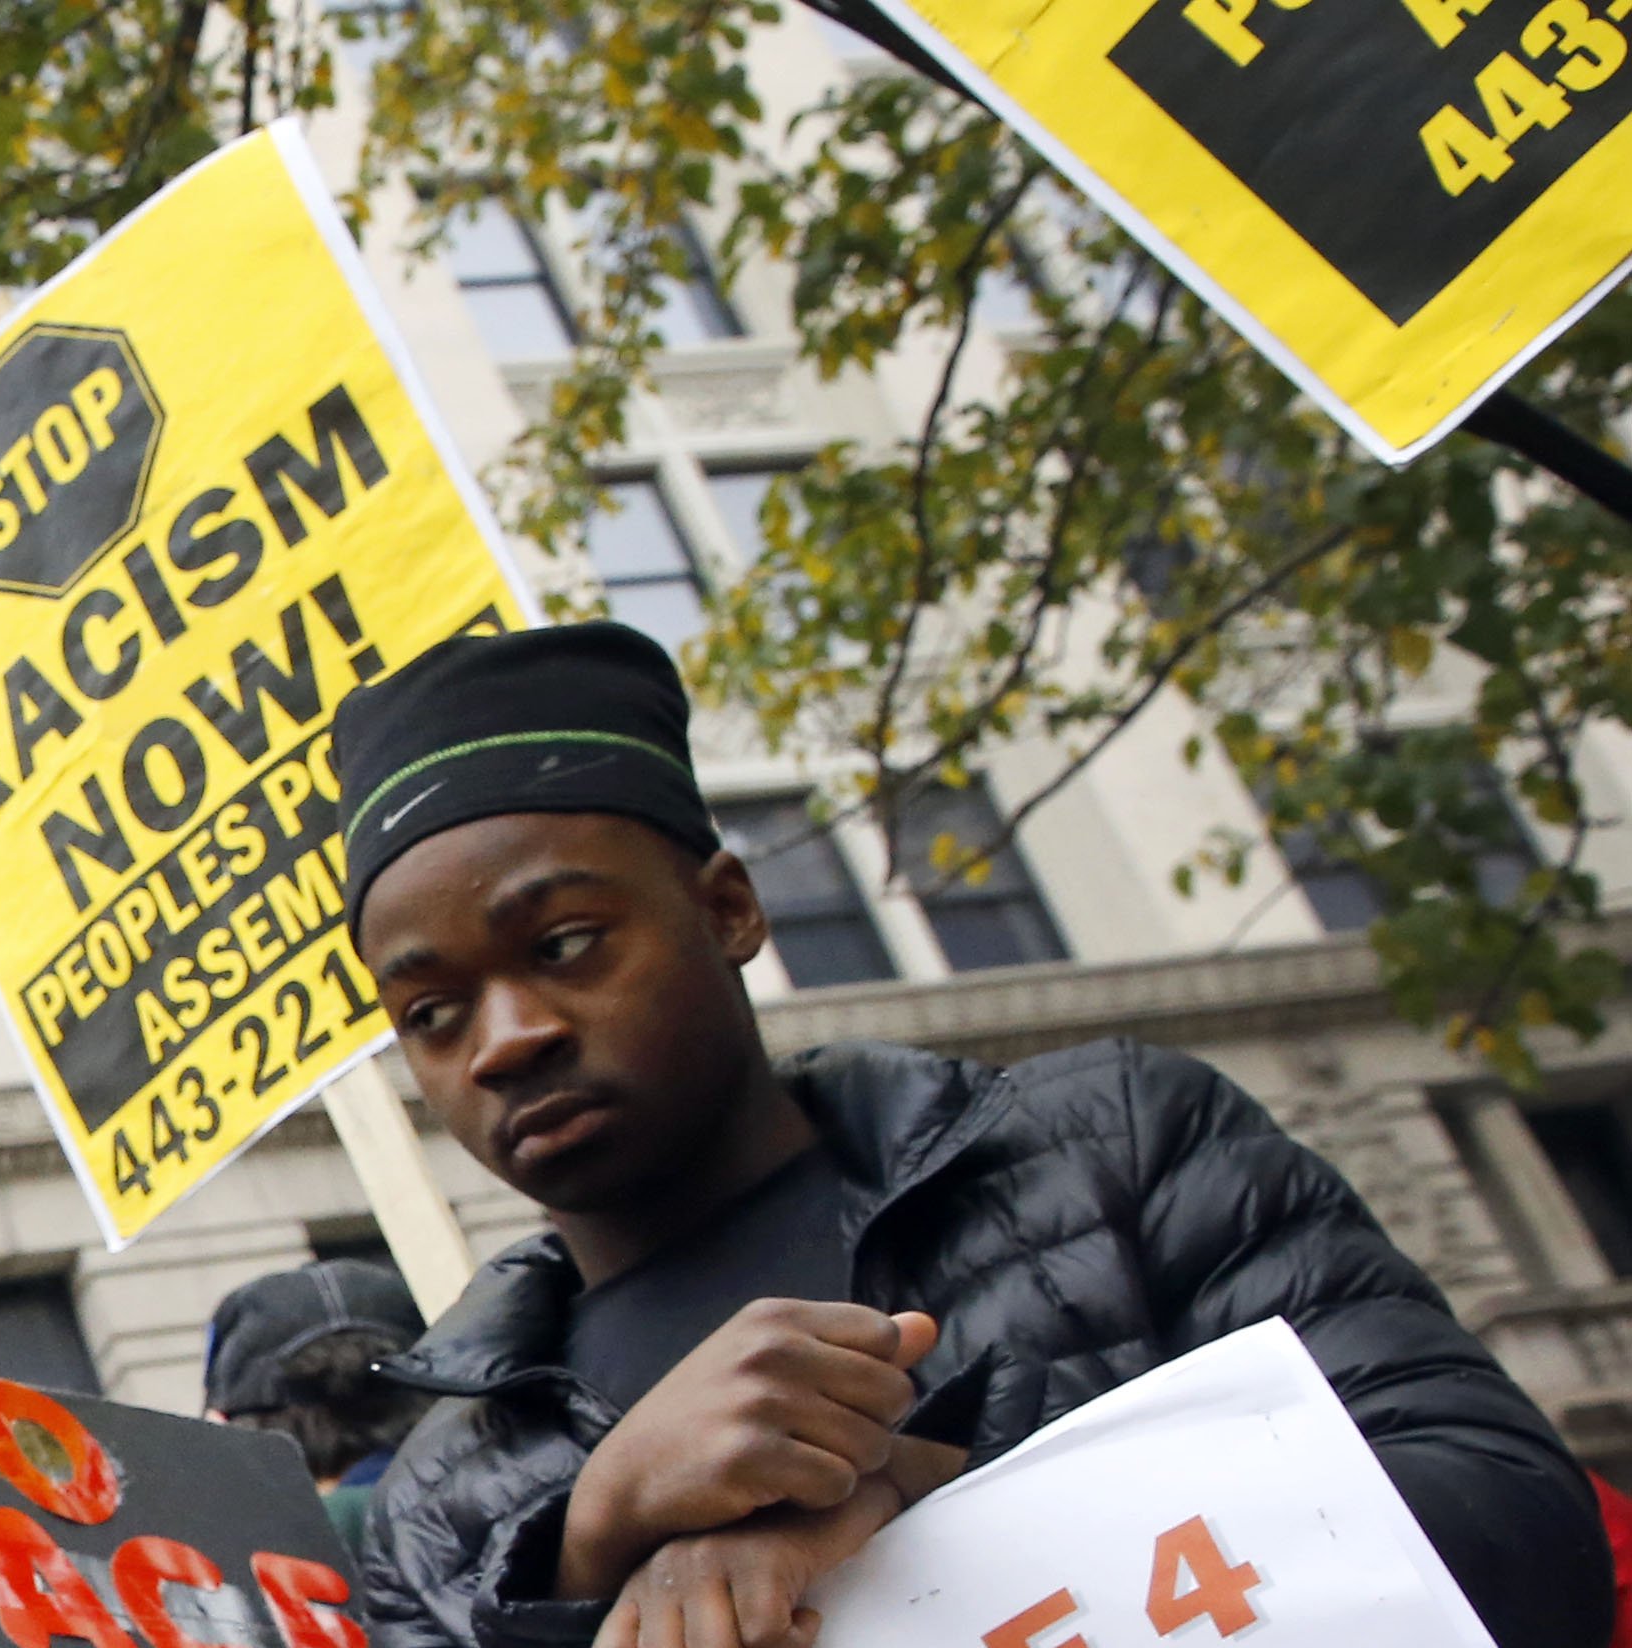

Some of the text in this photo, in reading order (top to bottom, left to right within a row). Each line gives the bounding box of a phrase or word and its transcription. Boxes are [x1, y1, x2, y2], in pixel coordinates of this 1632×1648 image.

[39, 572, 387, 913] NOW!
[27, 802, 266, 1046] PEOPLES
[136, 832, 347, 1064] ASSEM
[109, 948, 380, 1196] 443-221
[1144, 1514, 1262, 1640] 4
